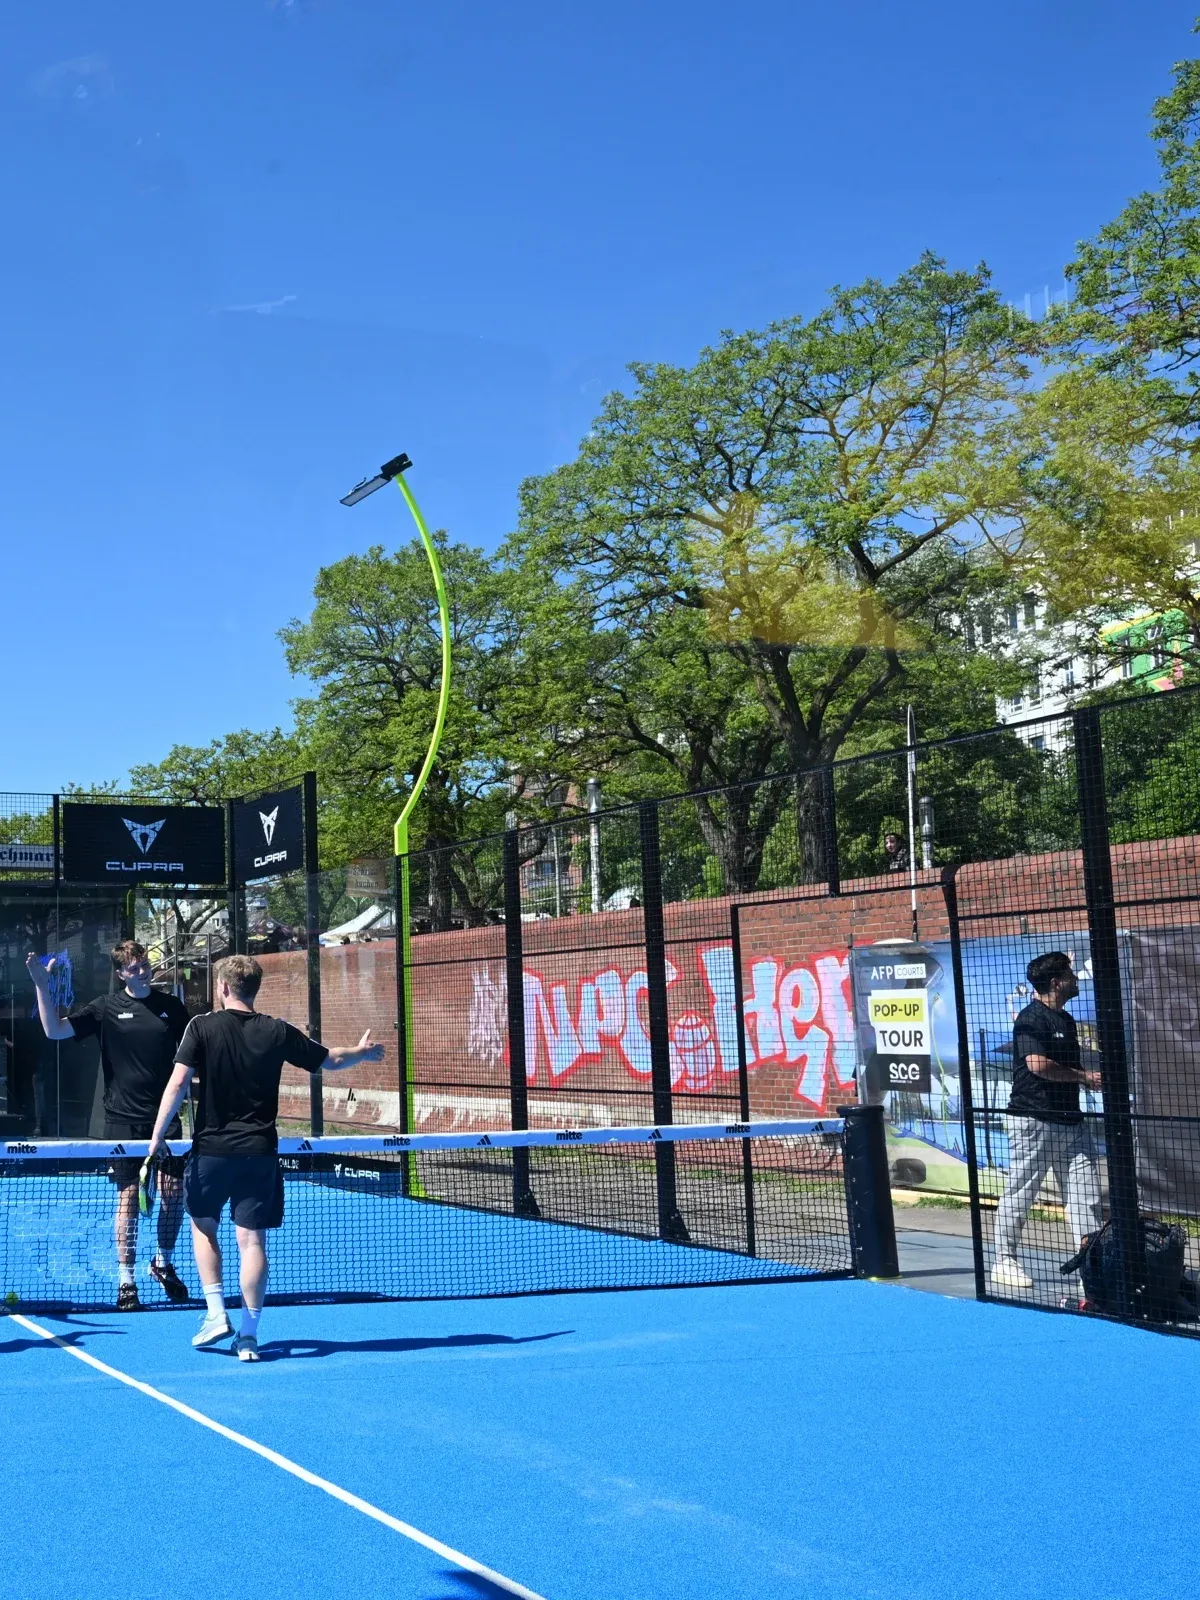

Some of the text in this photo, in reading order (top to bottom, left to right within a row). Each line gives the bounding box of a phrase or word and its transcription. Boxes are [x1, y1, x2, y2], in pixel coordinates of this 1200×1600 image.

[254, 850, 287, 868] CUPRA
[105, 861, 184, 872] CUPRA
[871, 966, 924, 980] AFP COURTS
[874, 1003, 920, 1017] POP-UP
[880, 1030, 924, 1047] TOUR
[725, 1124, 750, 1133] mitte
[383, 1136, 411, 1146] mitte
[556, 1130, 583, 1141] mitte
[7, 1143, 37, 1154] mitte
[345, 1167, 380, 1181] CUPRA
